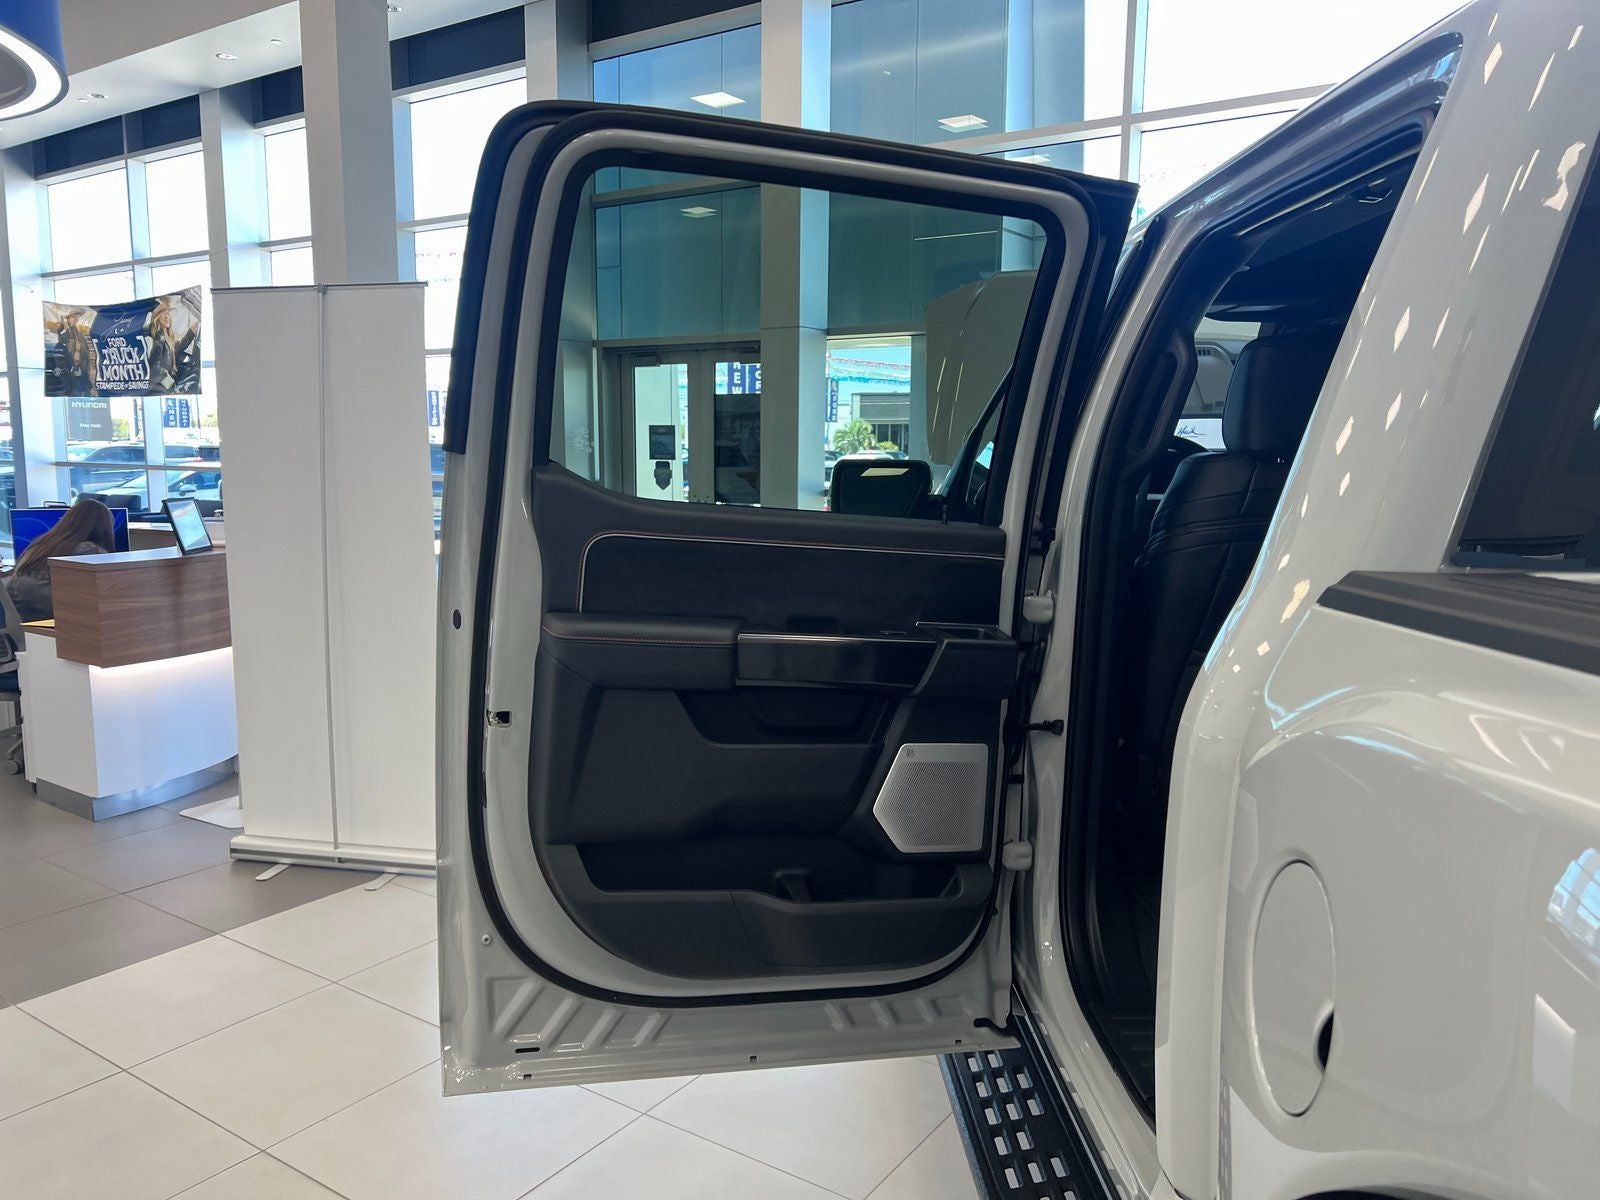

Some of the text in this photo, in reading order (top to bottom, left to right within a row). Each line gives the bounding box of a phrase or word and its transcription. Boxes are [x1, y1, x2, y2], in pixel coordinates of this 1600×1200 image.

[107, 337, 127, 347] FORD
[102, 347, 140, 364] TRUCK
[102, 364, 144, 380] MONTH
[71, 401, 107, 409] HYUNDAI
